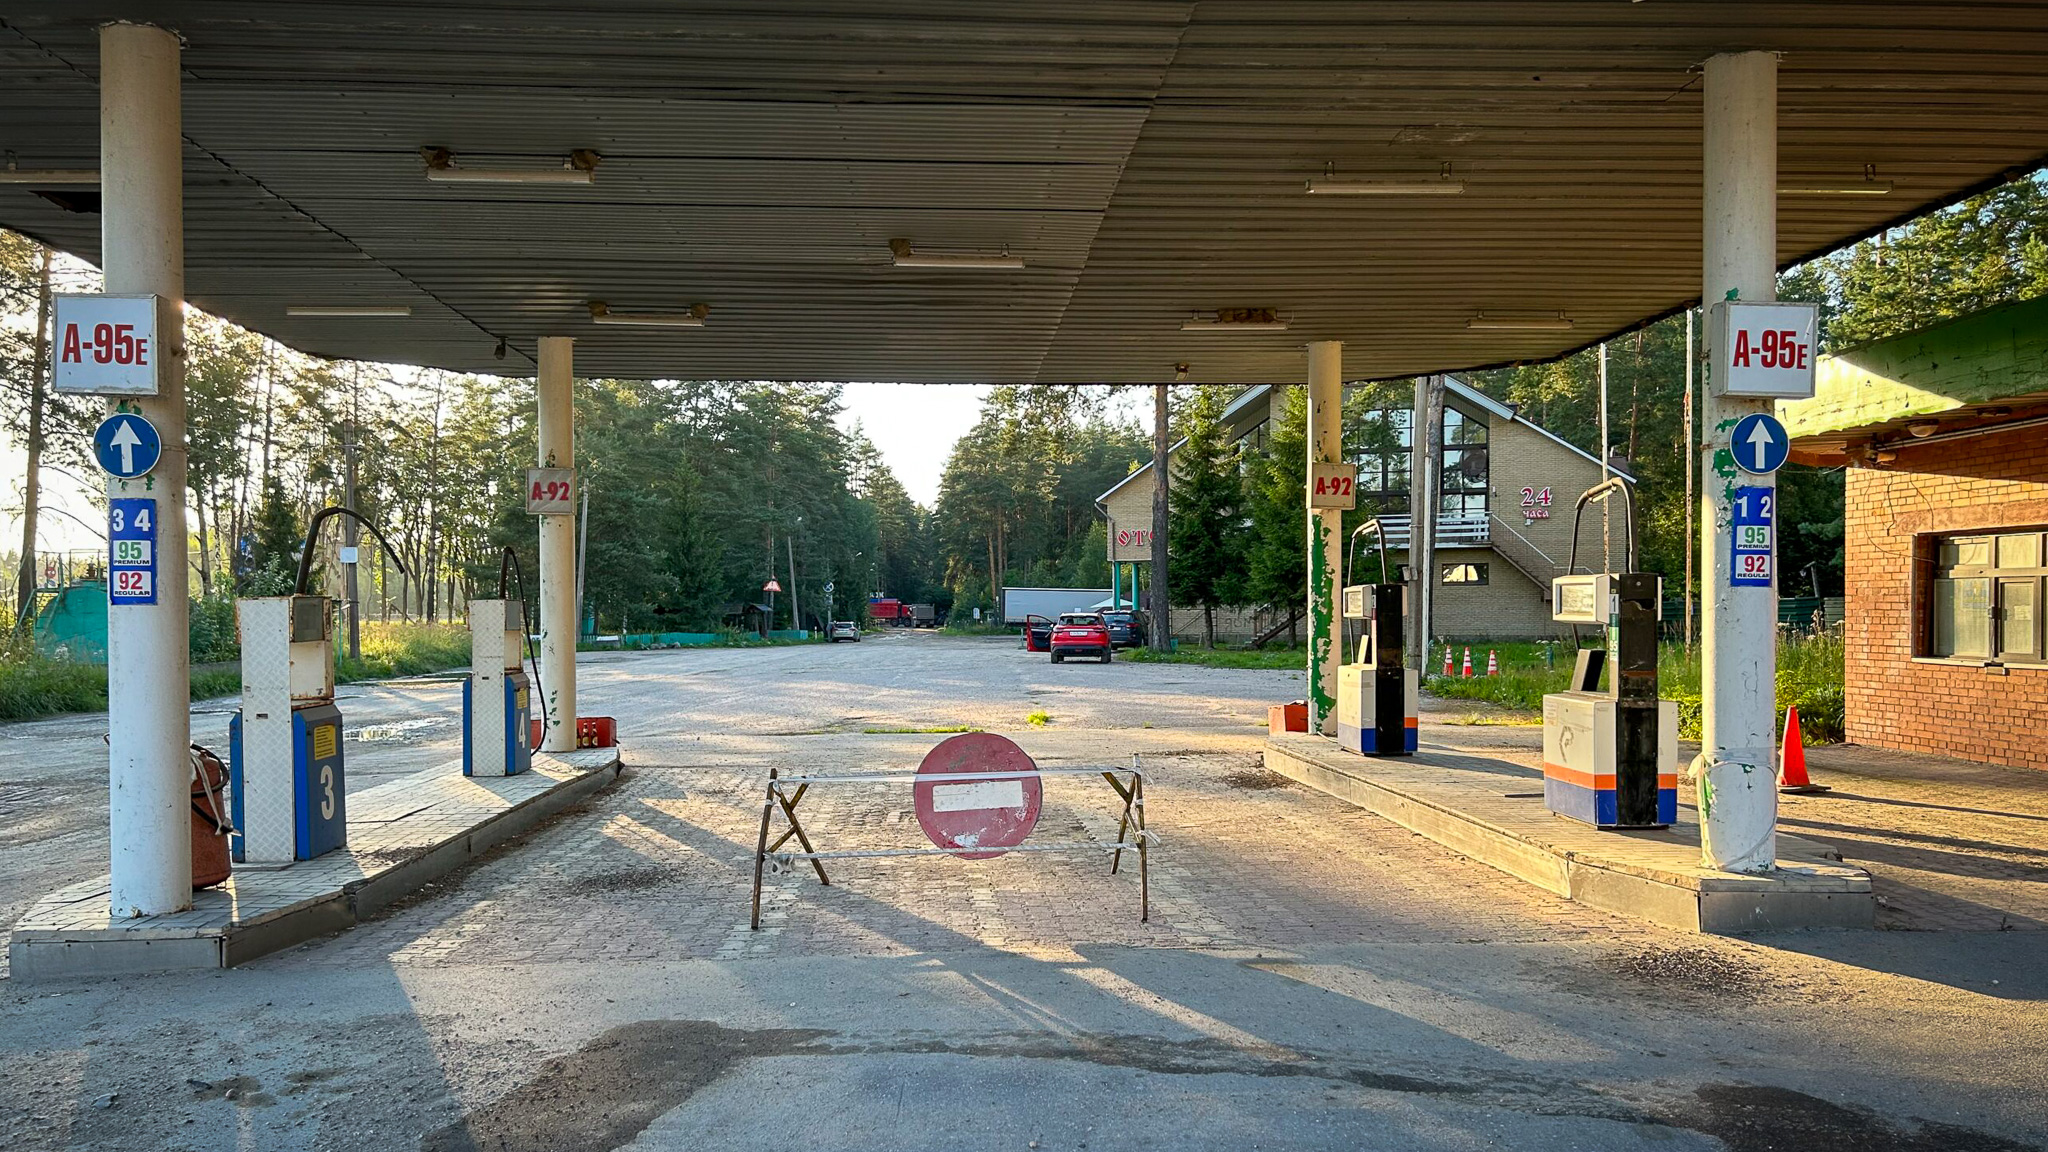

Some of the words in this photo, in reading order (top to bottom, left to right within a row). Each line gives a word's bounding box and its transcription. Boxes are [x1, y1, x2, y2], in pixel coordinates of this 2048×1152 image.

[61, 323, 148, 366] A-95E
[1732, 329, 1808, 370] A-95E
[531, 481, 570, 501] A-92
[1315, 476, 1352, 496] A-92
[1520, 486, 1553, 507] 24
[1736, 495, 1748, 518] 1
[1760, 495, 1771, 518] 2
[112, 508, 125, 532] 3
[134, 508, 151, 532] 4
[1522, 509, 1550, 518] часа
[1744, 526, 1766, 544] 95
[118, 541, 143, 560] 95
[1744, 555, 1766, 573] 92
[119, 572, 143, 590] 92
[518, 712, 526, 749] 4
[320, 764, 335, 821] 3
